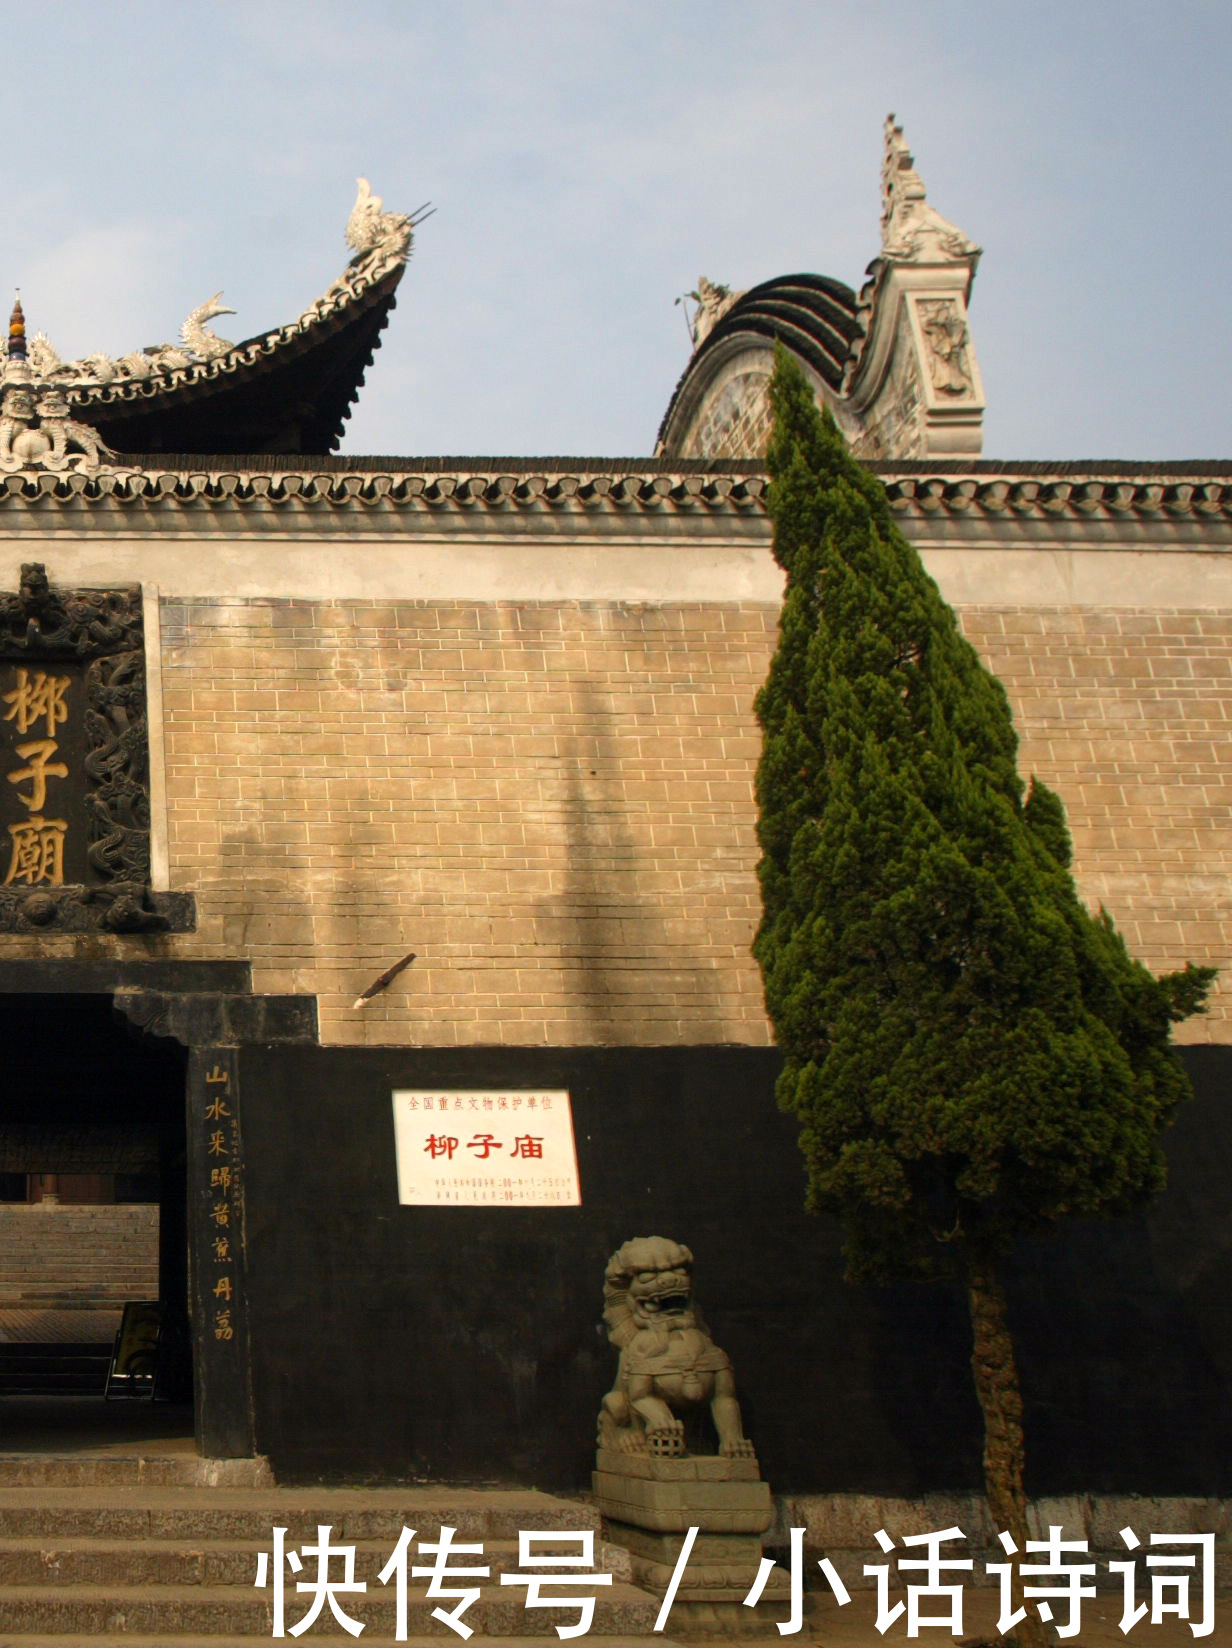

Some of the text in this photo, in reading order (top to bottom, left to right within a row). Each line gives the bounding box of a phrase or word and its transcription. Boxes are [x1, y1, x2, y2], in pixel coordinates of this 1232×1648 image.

[408, 1096, 553, 1111] 全国重点文物保护单位
[424, 1134, 544, 1160] 柳子庙
